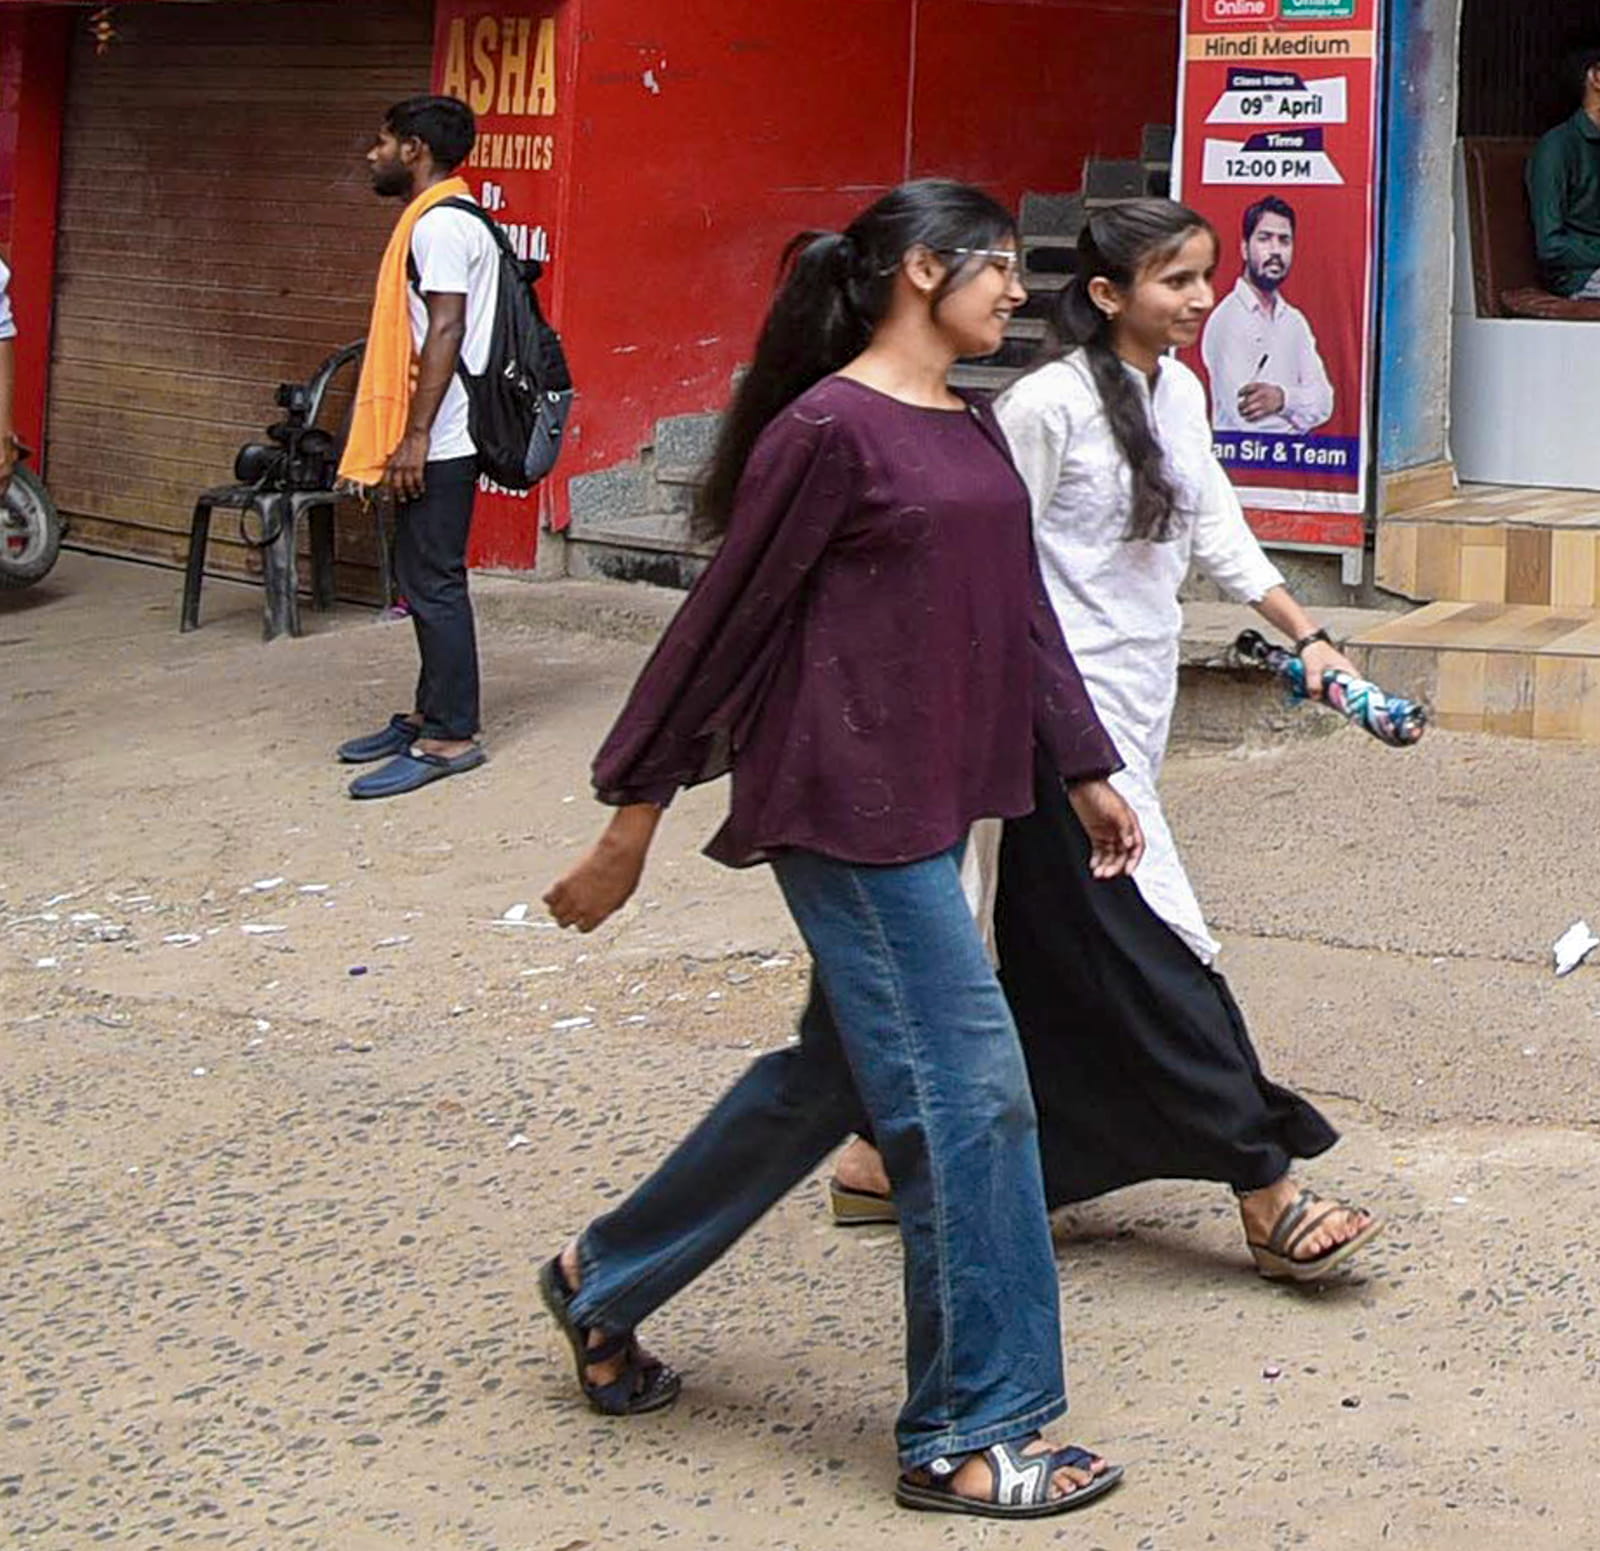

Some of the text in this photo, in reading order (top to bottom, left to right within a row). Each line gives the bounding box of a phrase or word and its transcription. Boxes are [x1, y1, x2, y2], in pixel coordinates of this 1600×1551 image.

[1205, 35, 1350, 56] Hindi Medium
[443, 15, 556, 116] ASHA
[1279, 97, 1322, 119] April
[1226, 159, 1311, 178] 12:00 PM
[1240, 438, 1347, 466] Sir & Team
